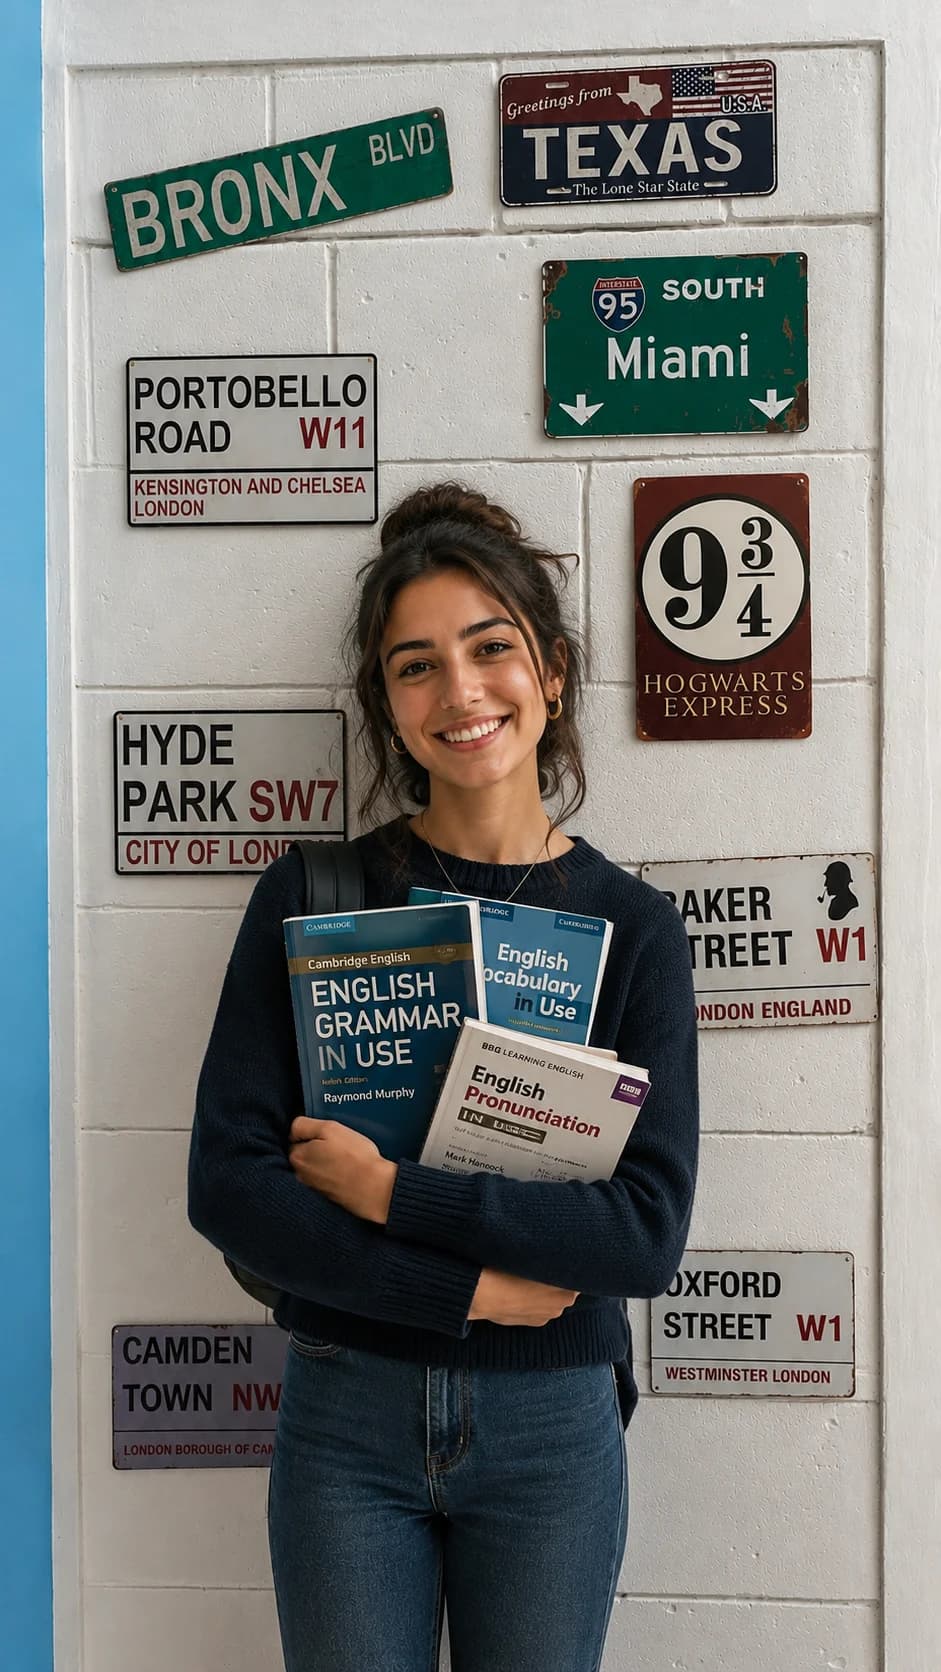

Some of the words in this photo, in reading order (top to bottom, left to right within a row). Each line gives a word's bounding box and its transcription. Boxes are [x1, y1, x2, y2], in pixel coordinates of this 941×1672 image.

[506, 93, 574, 120] Greetings
[576, 87, 613, 106] from
[720, 95, 768, 113] U.S.A.
[522, 119, 743, 180] TEXAS
[121, 144, 348, 259] BRONX
[368, 122, 436, 167] BLVD
[573, 183, 598, 196] The
[601, 181, 634, 195] Lone
[638, 180, 664, 194] Star
[667, 179, 700, 193] State
[662, 276, 765, 301] SOUTH
[598, 292, 638, 321] 95
[607, 332, 749, 380] Miami
[134, 374, 367, 410] PORTOBELLO
[135, 420, 231, 454] ROAD
[299, 416, 365, 449] W11
[134, 478, 242, 496] KENSINGTON
[247, 478, 283, 495] AND
[287, 476, 366, 494] CHELSEA
[134, 500, 205, 517] LONDON
[644, 671, 805, 694] HOGWARTS
[664, 695, 789, 718] EXPRESS
[122, 724, 234, 766] HYDE
[123, 780, 238, 823] PARK
[249, 779, 339, 823] SW7
[126, 839, 181, 865] CITY
[187, 839, 220, 865] OF
[308, 955, 368, 971] Cambridge
[370, 951, 411, 967] English
[497, 943, 569, 972] English
[688, 930, 793, 970] TREET
[815, 926, 867, 963] W1
[311, 971, 436, 1007] ENGLISH
[484, 967, 582, 1001] ocabulary
[315, 1002, 462, 1039] GRAMMAR
[514, 992, 534, 1013] in
[540, 996, 577, 1020] Use
[761, 998, 851, 1019] ENGLAND
[318, 1045, 347, 1072] IN
[355, 1038, 414, 1068] USE
[503, 1048, 546, 1068] LEARNING
[547, 1062, 585, 1080] ENGLISH
[324, 1089, 373, 1105] Raymond
[375, 1087, 415, 1102] Murphy
[471, 1064, 545, 1101] English
[463, 1110, 484, 1124] IN
[464, 1085, 601, 1138] Pronunciation
[664, 1312, 772, 1341] STREET
[796, 1314, 841, 1342] W1
[122, 1335, 252, 1365] CAMDEN
[665, 1366, 768, 1383] WESTMINSTER
[772, 1369, 831, 1384] LONDON
[122, 1383, 213, 1412] TOWN
[124, 1444, 172, 1456] LONDON
[175, 1444, 231, 1455] BOROUGH
[235, 1444, 250, 1455] OF
